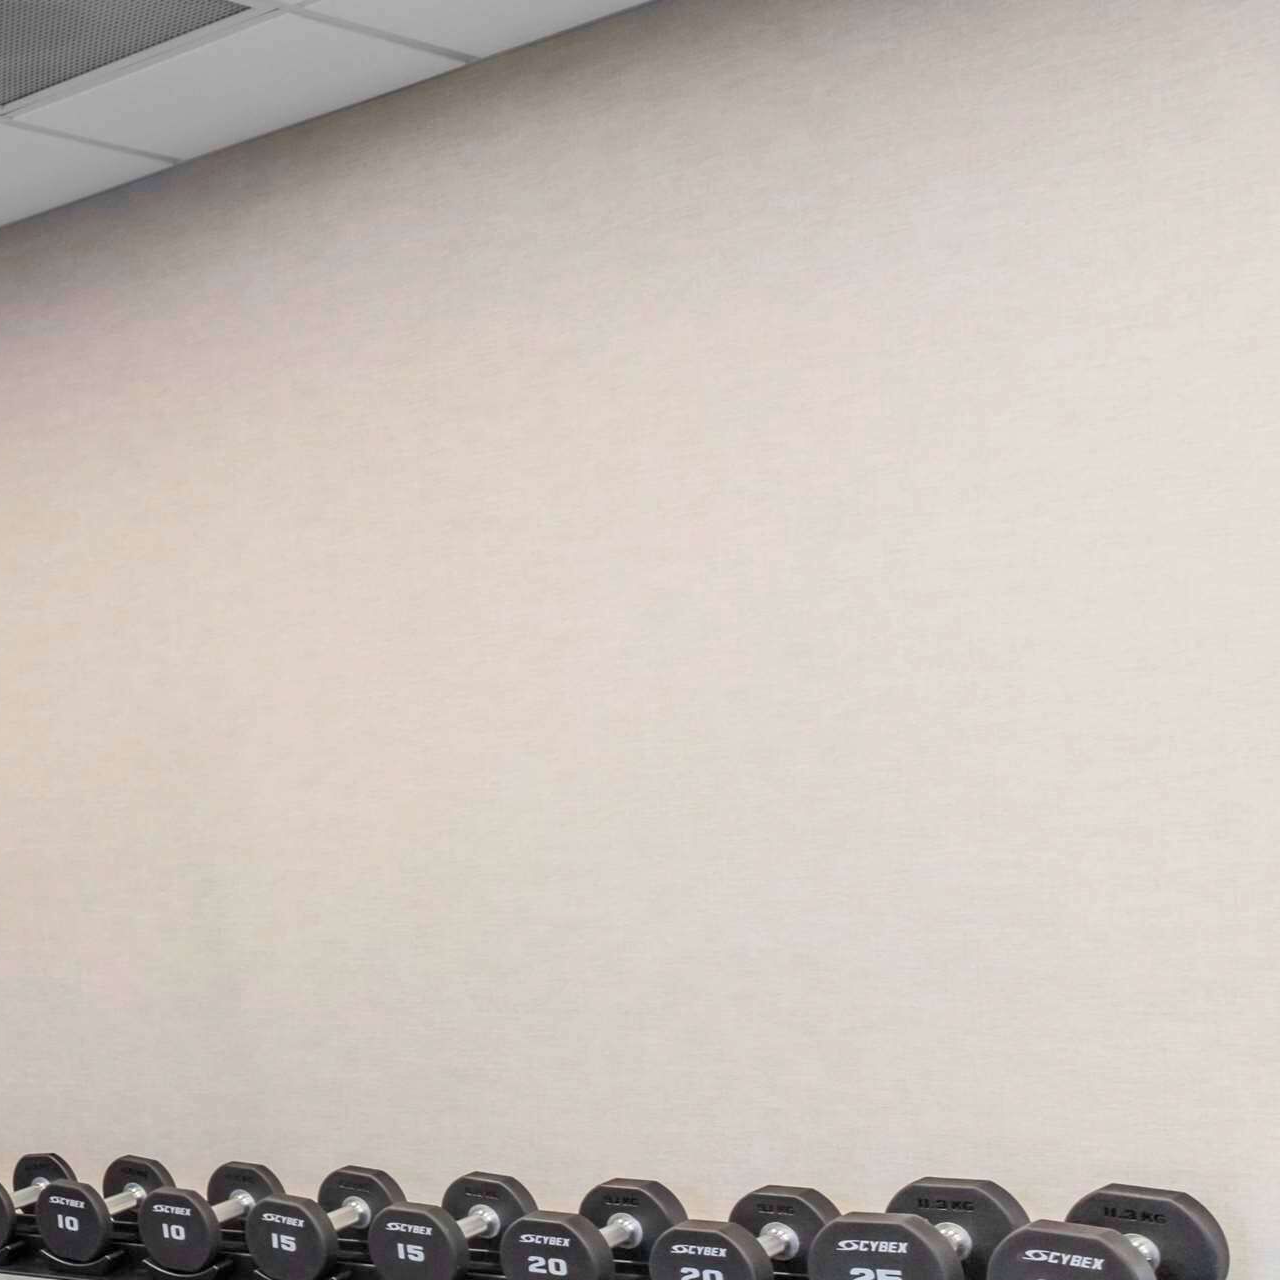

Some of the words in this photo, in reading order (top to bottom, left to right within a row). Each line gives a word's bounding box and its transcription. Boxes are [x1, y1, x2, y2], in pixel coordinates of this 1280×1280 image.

[59, 1196, 86, 1209] CYBEX
[163, 1205, 191, 1217] CYBEX
[57, 1214, 80, 1232] 10
[275, 1215, 305, 1228] CYBEX
[162, 1224, 186, 1241] 10
[399, 1223, 433, 1236] CYBEX
[271, 1233, 297, 1253] 15
[533, 1234, 570, 1248] CYBEX
[859, 1240, 909, 1254] CYBEX
[397, 1243, 425, 1263] 15
[687, 1245, 728, 1258] CYBEX
[528, 1255, 569, 1276] 20
[1047, 1252, 1105, 1271] CYBEX
